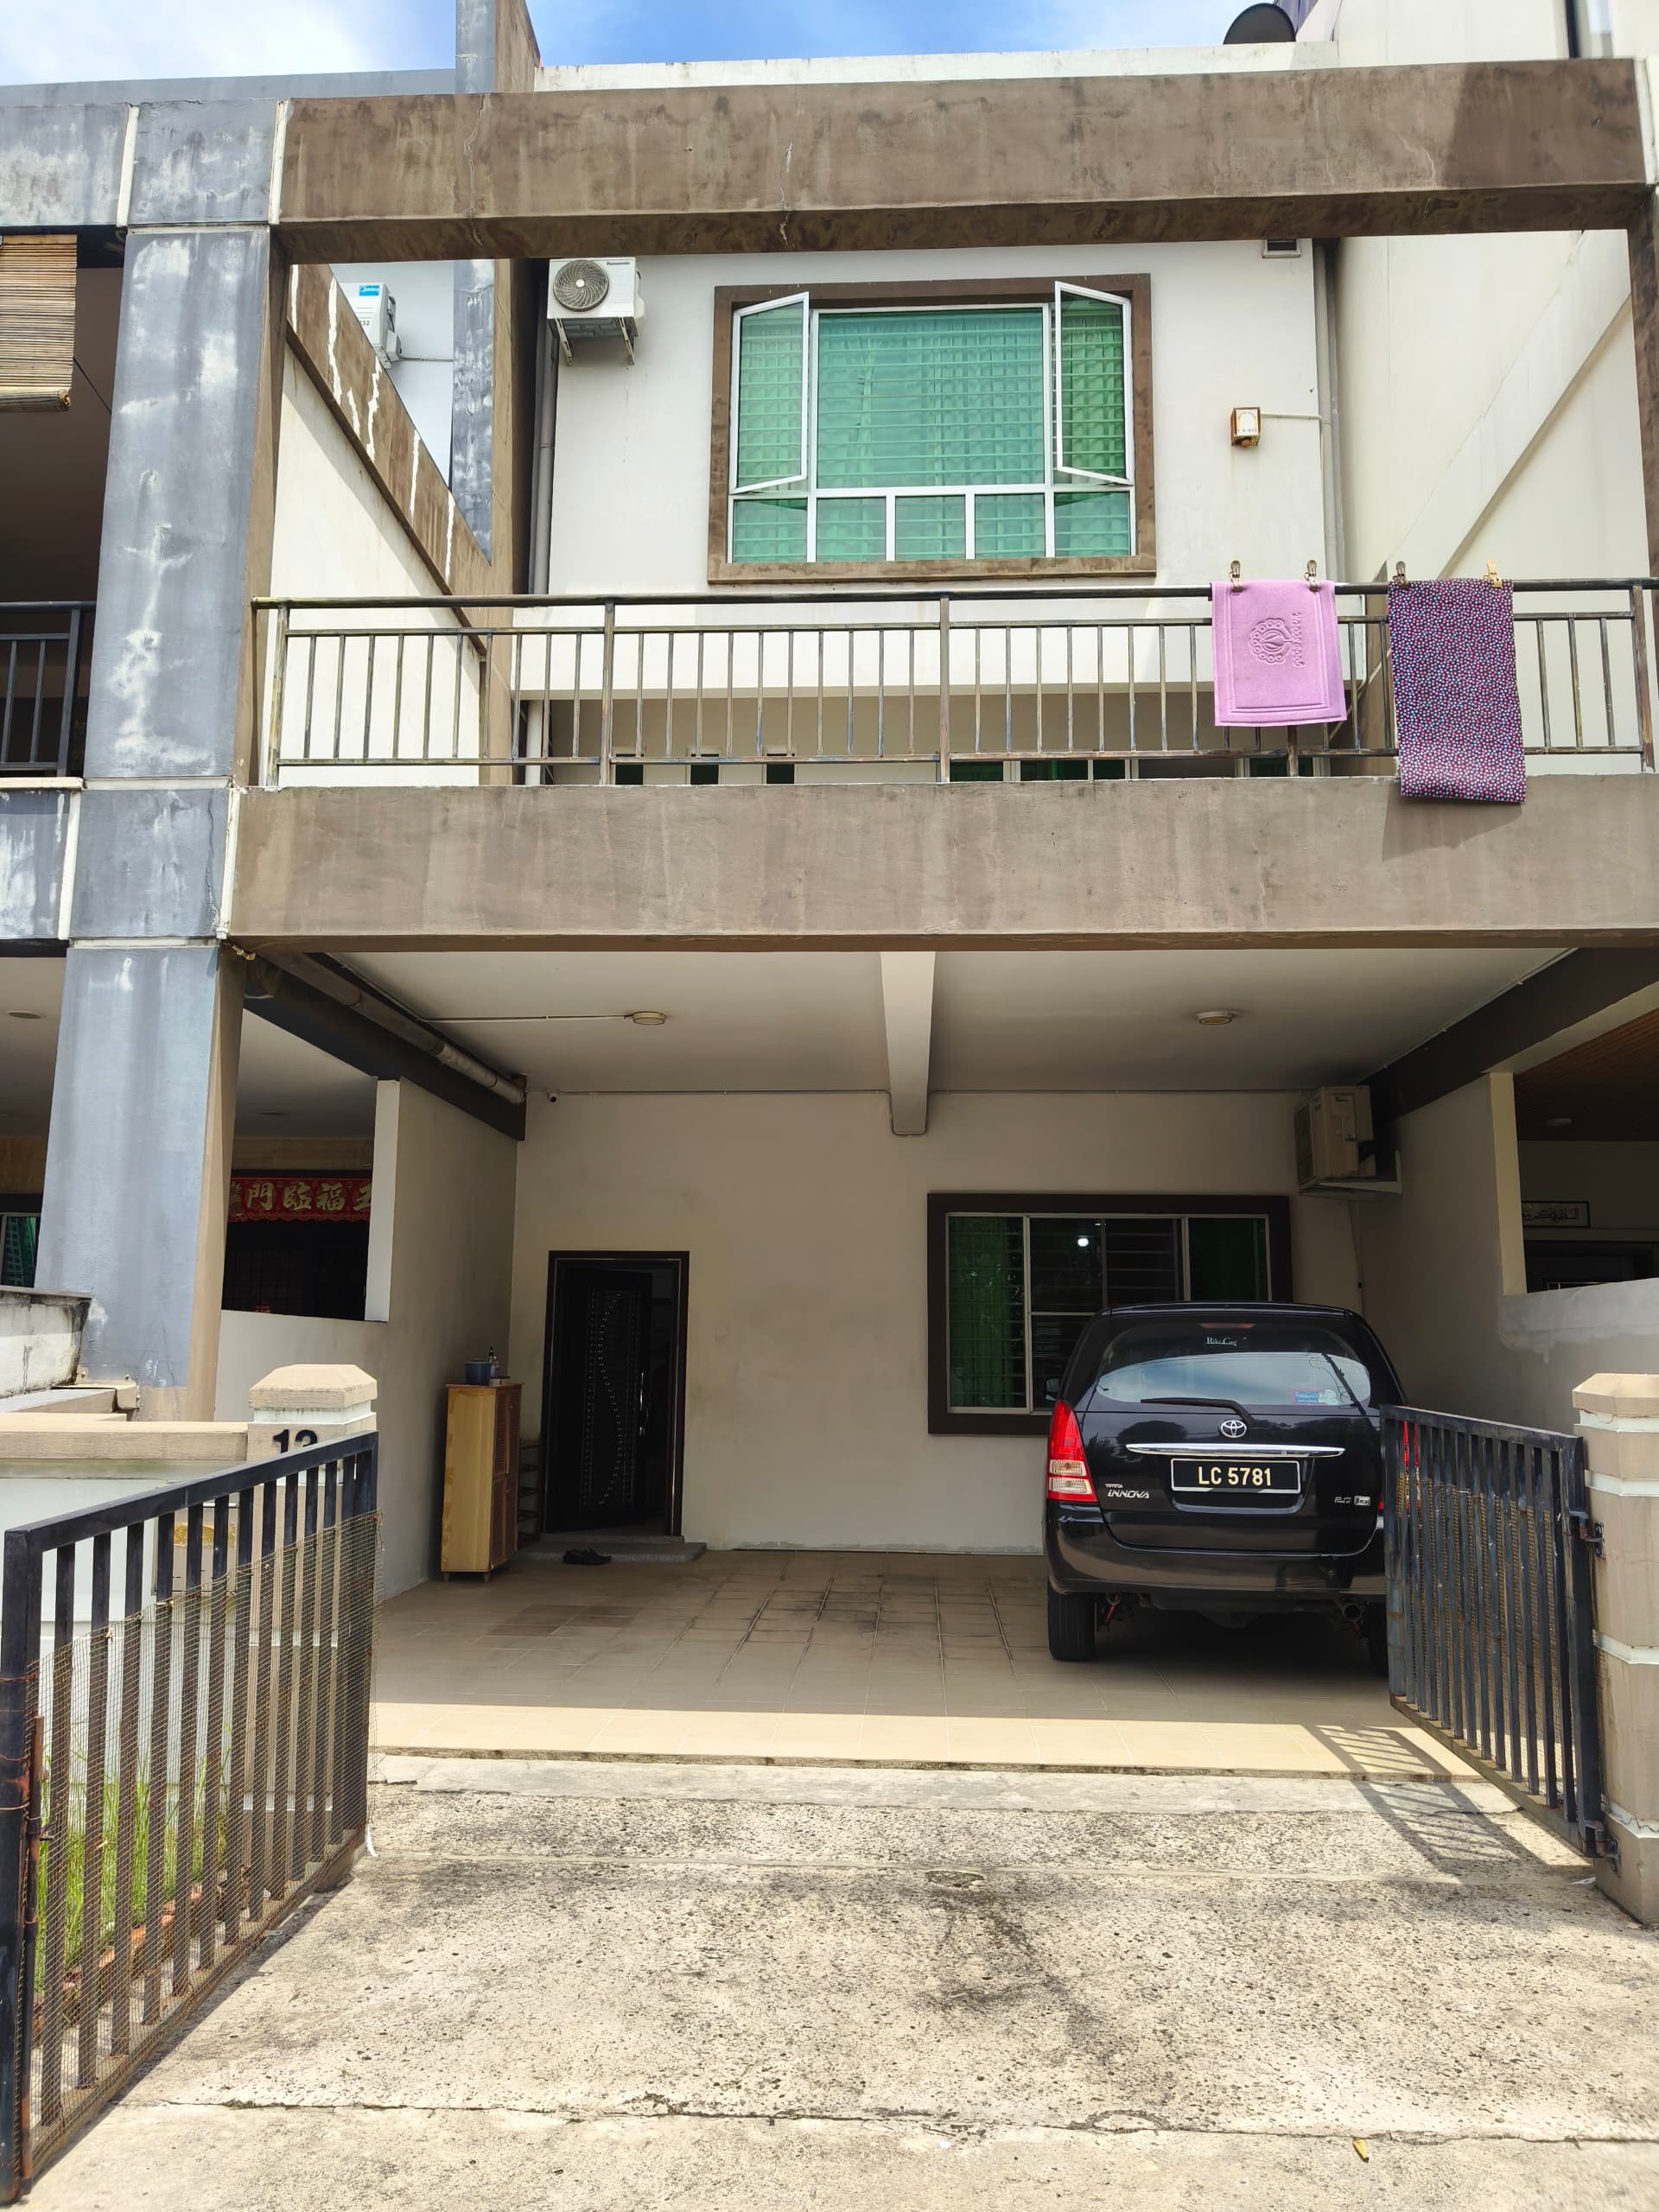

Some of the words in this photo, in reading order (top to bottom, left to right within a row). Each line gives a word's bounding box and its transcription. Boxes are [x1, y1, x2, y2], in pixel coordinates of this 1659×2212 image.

[1198, 1466, 1222, 1484] LC
[1228, 1467, 1271, 1486] 5781
[1107, 1489, 1149, 1498] INNOVA
